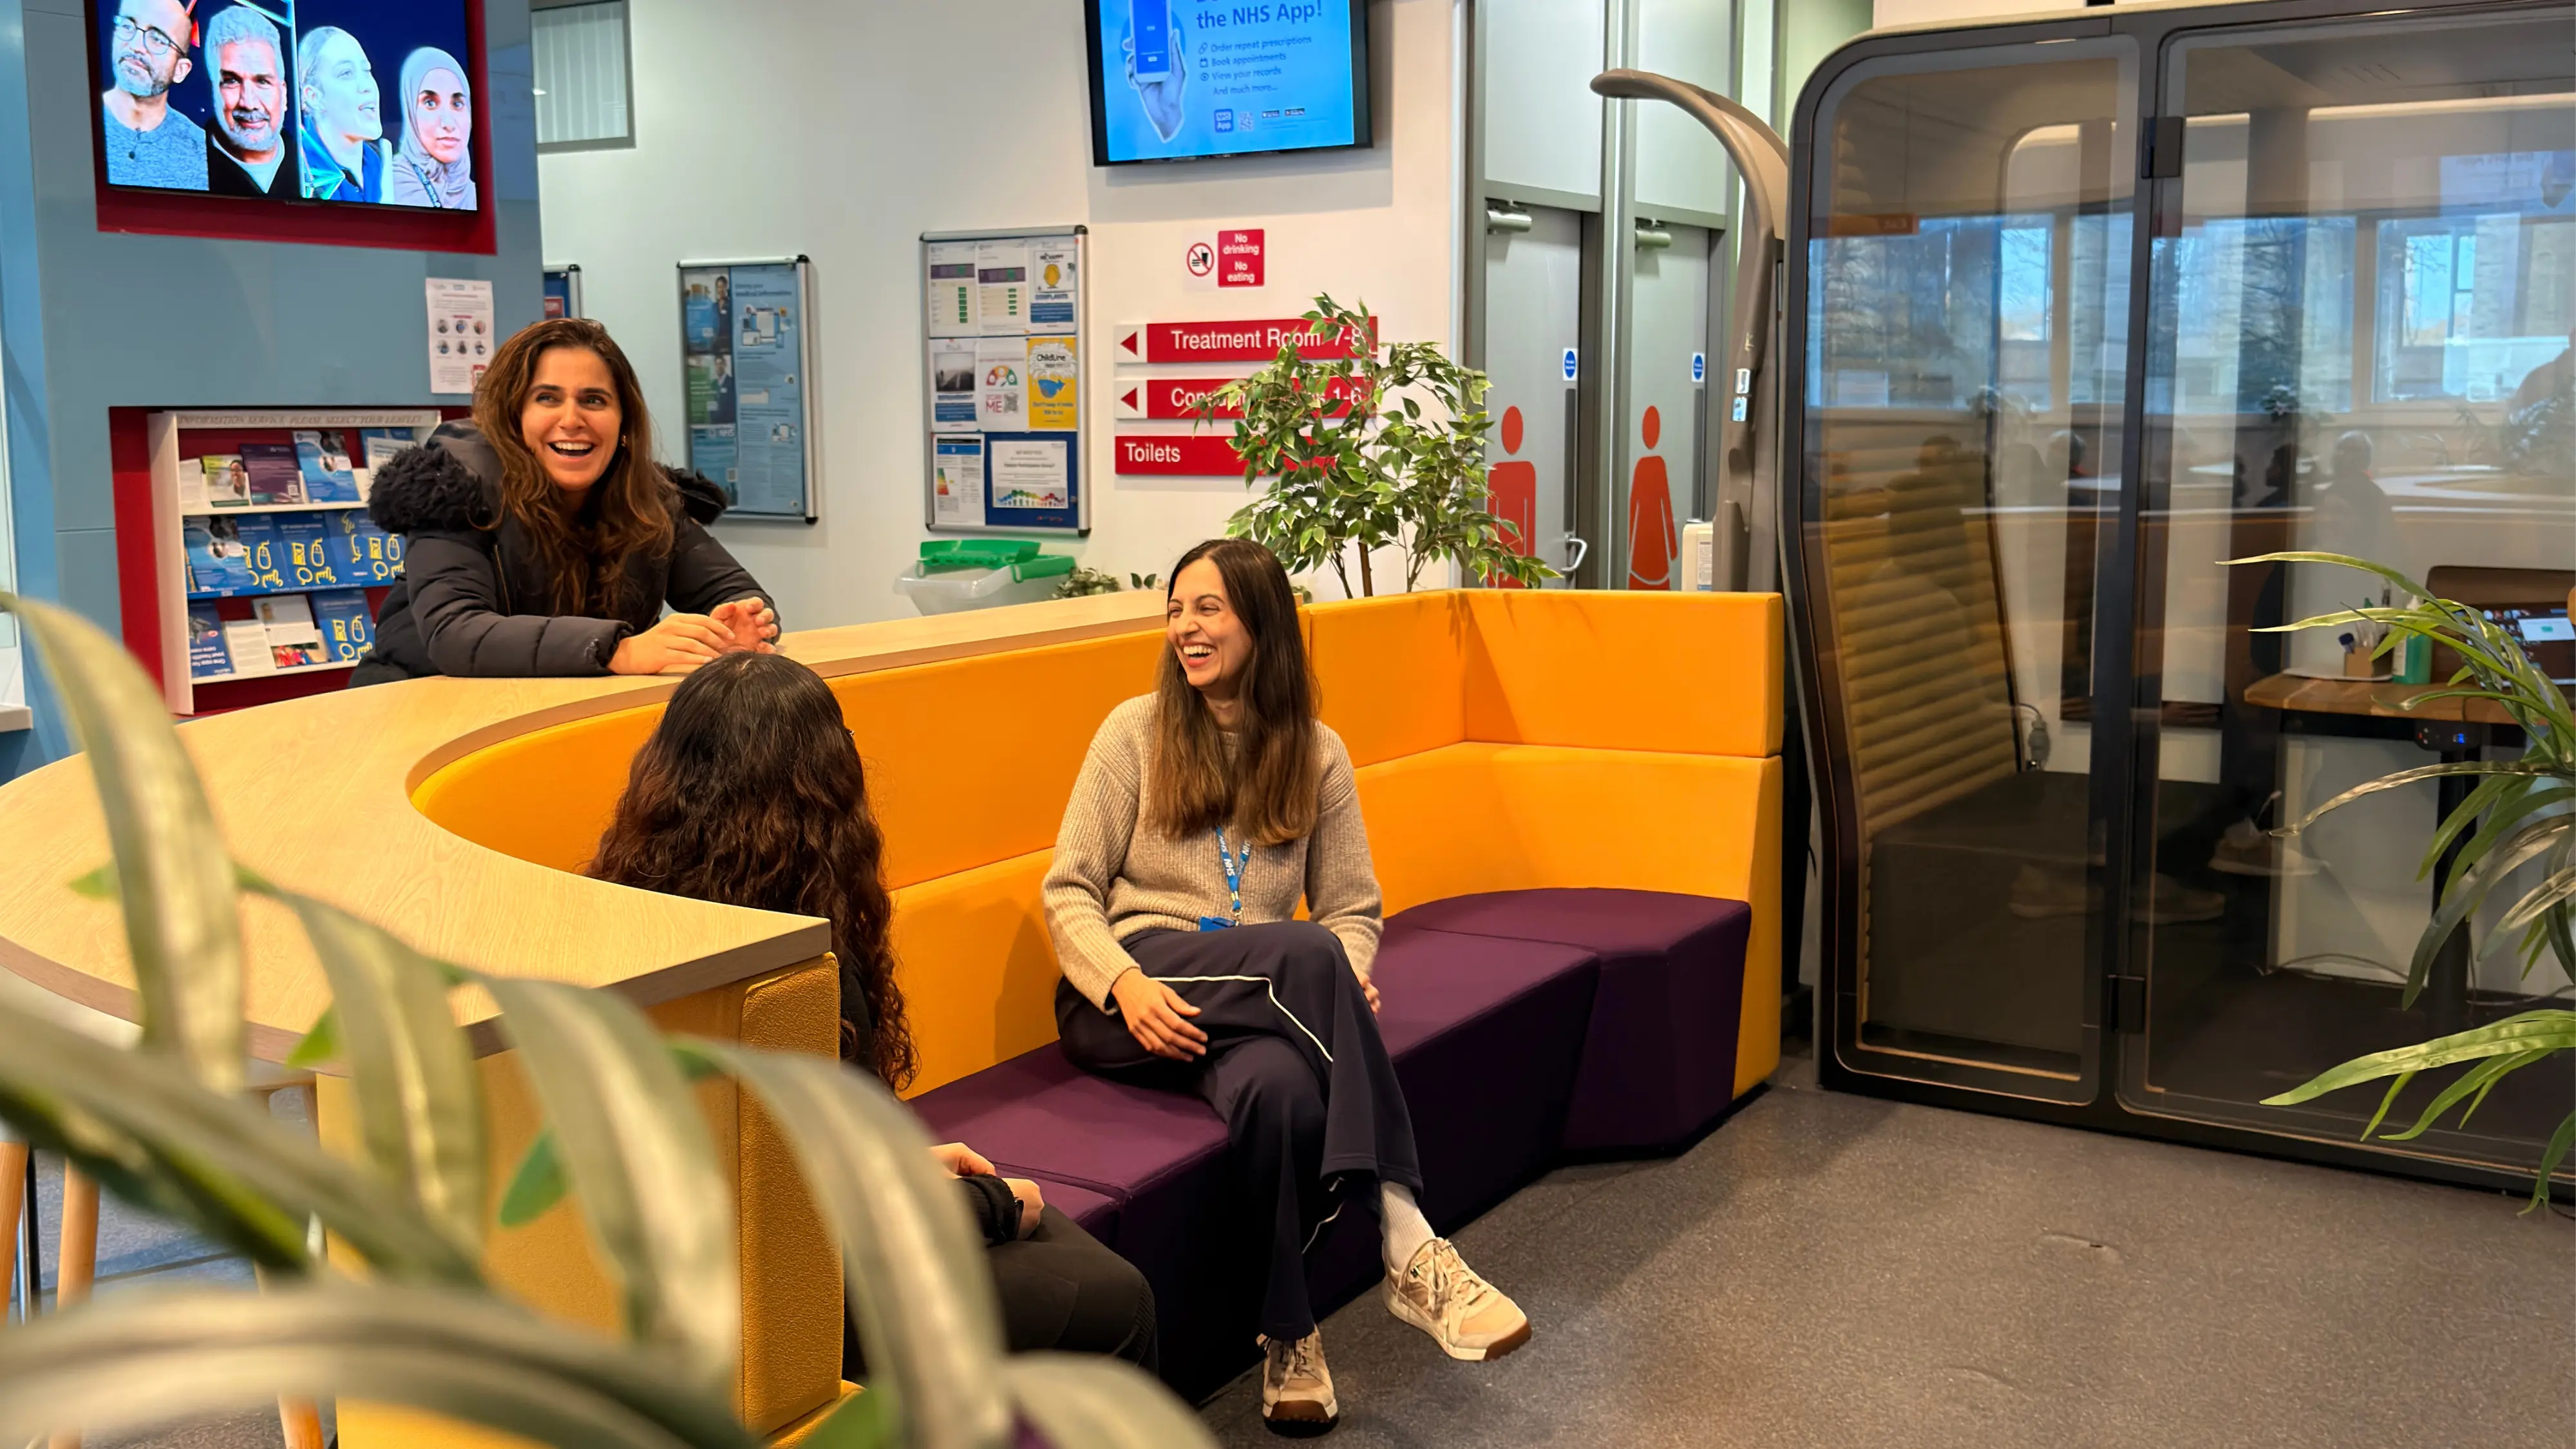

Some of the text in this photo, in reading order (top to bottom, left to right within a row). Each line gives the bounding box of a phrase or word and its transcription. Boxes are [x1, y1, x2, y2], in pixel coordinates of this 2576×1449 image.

[1197, 0, 1322, 29] the NHS App!
[1211, 36, 1312, 52] Order repeat prescriptions
[1211, 52, 1287, 67] Book appointments
[1212, 65, 1282, 81] View your records
[1213, 86, 1228, 96] And
[1230, 84, 1250, 94] much
[1216, 111, 1231, 121] NHS
[1235, 233, 1248, 243] No
[1223, 243, 1260, 256] drinking
[1235, 261, 1248, 271] No
[1227, 272, 1255, 283] eating
[1171, 329, 1260, 349] Treatment
[1267, 327, 1320, 348] Room
[985, 400, 1003, 413] ME
[1124, 442, 1181, 462] Toilets
[1218, 835, 1229, 853] NHS
[1242, 839, 1251, 856] NH
[1223, 858, 1235, 876] NHS
